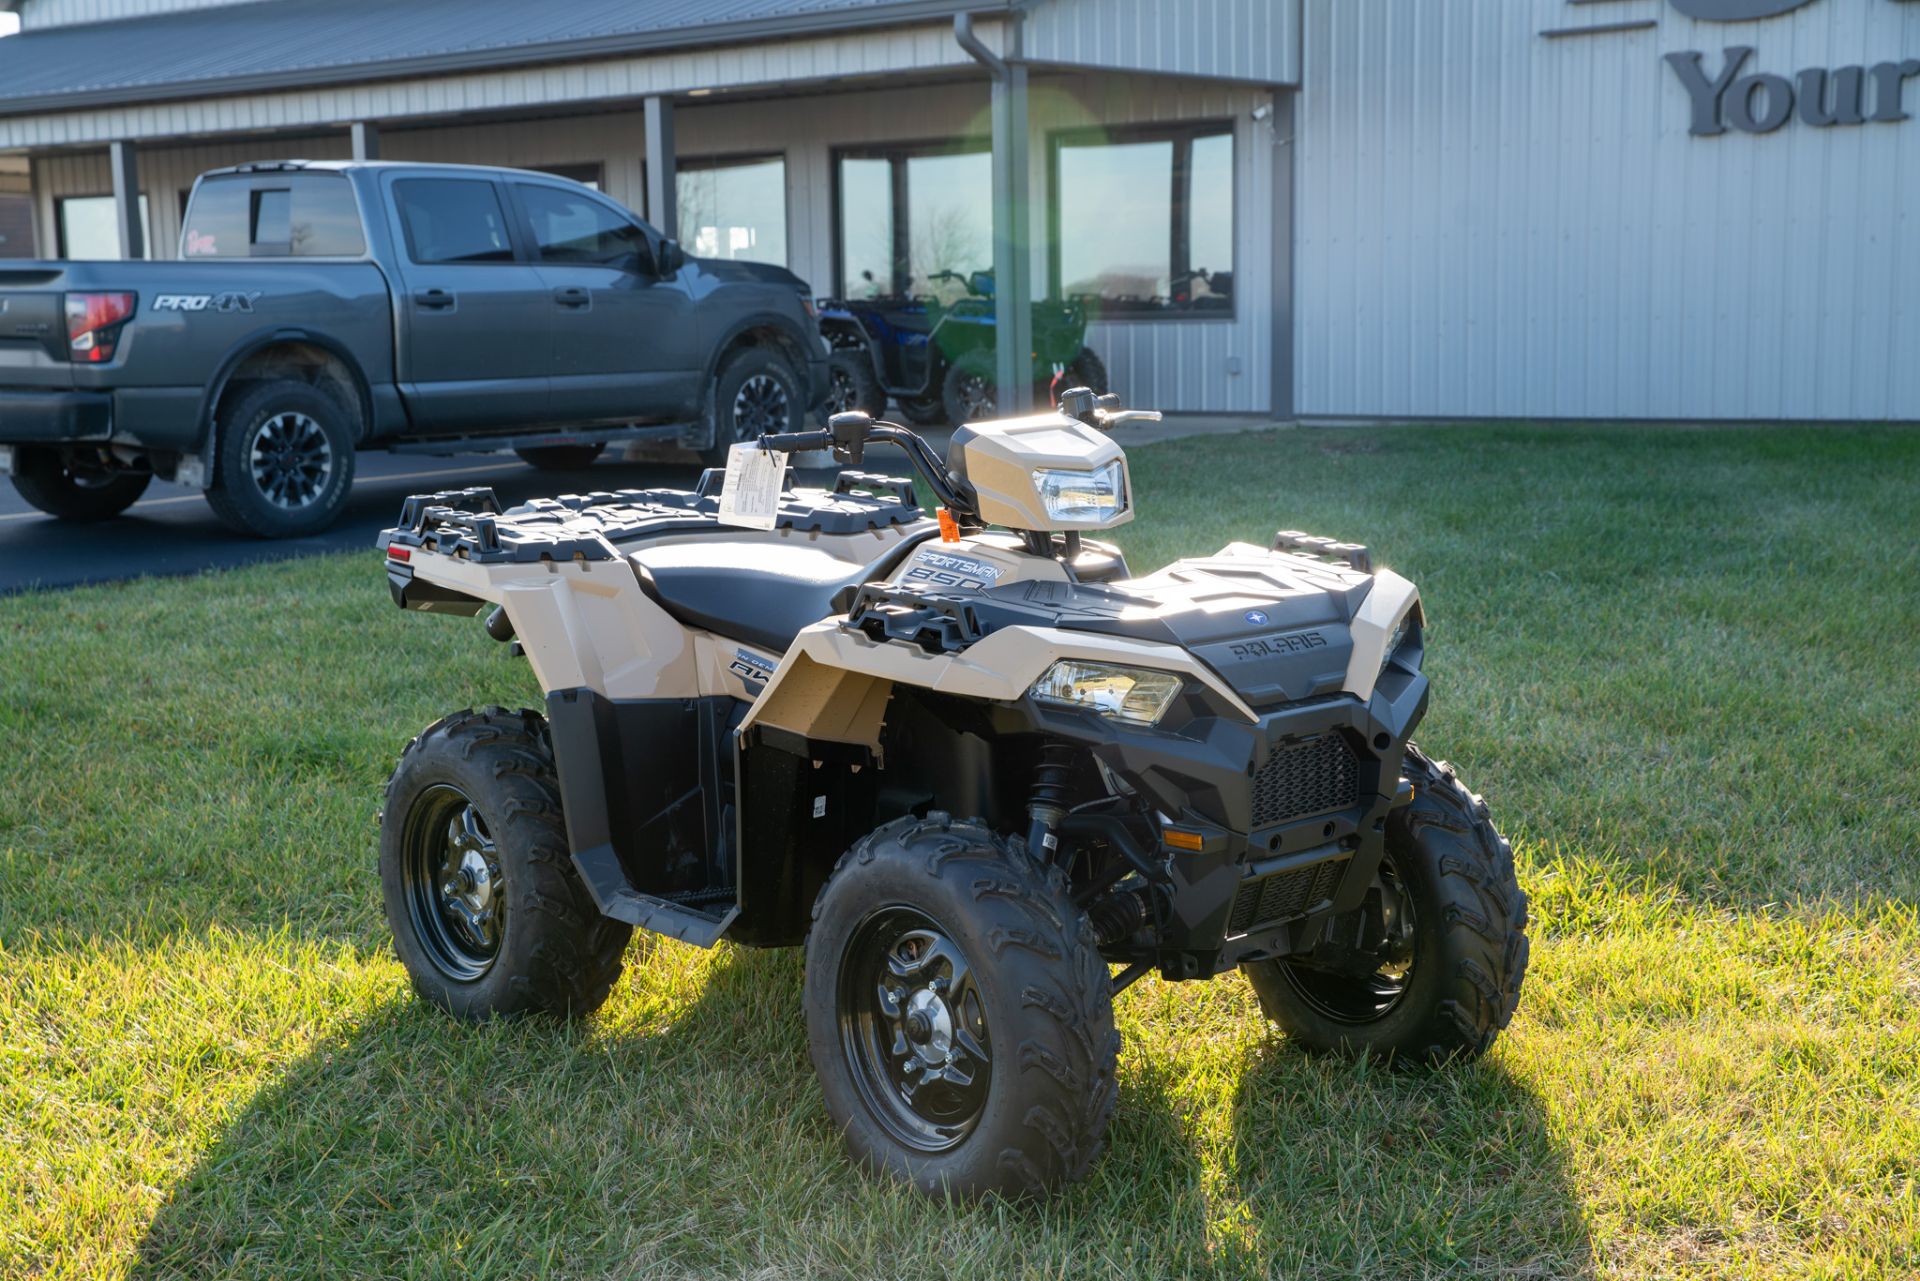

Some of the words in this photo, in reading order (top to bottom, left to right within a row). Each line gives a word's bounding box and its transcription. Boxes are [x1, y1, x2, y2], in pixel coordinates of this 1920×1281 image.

[1664, 45, 1920, 136] Your
[907, 567, 986, 591] 850
[914, 551, 1007, 579] SPORTSMAN
[1229, 632, 1328, 660] POLARIS
